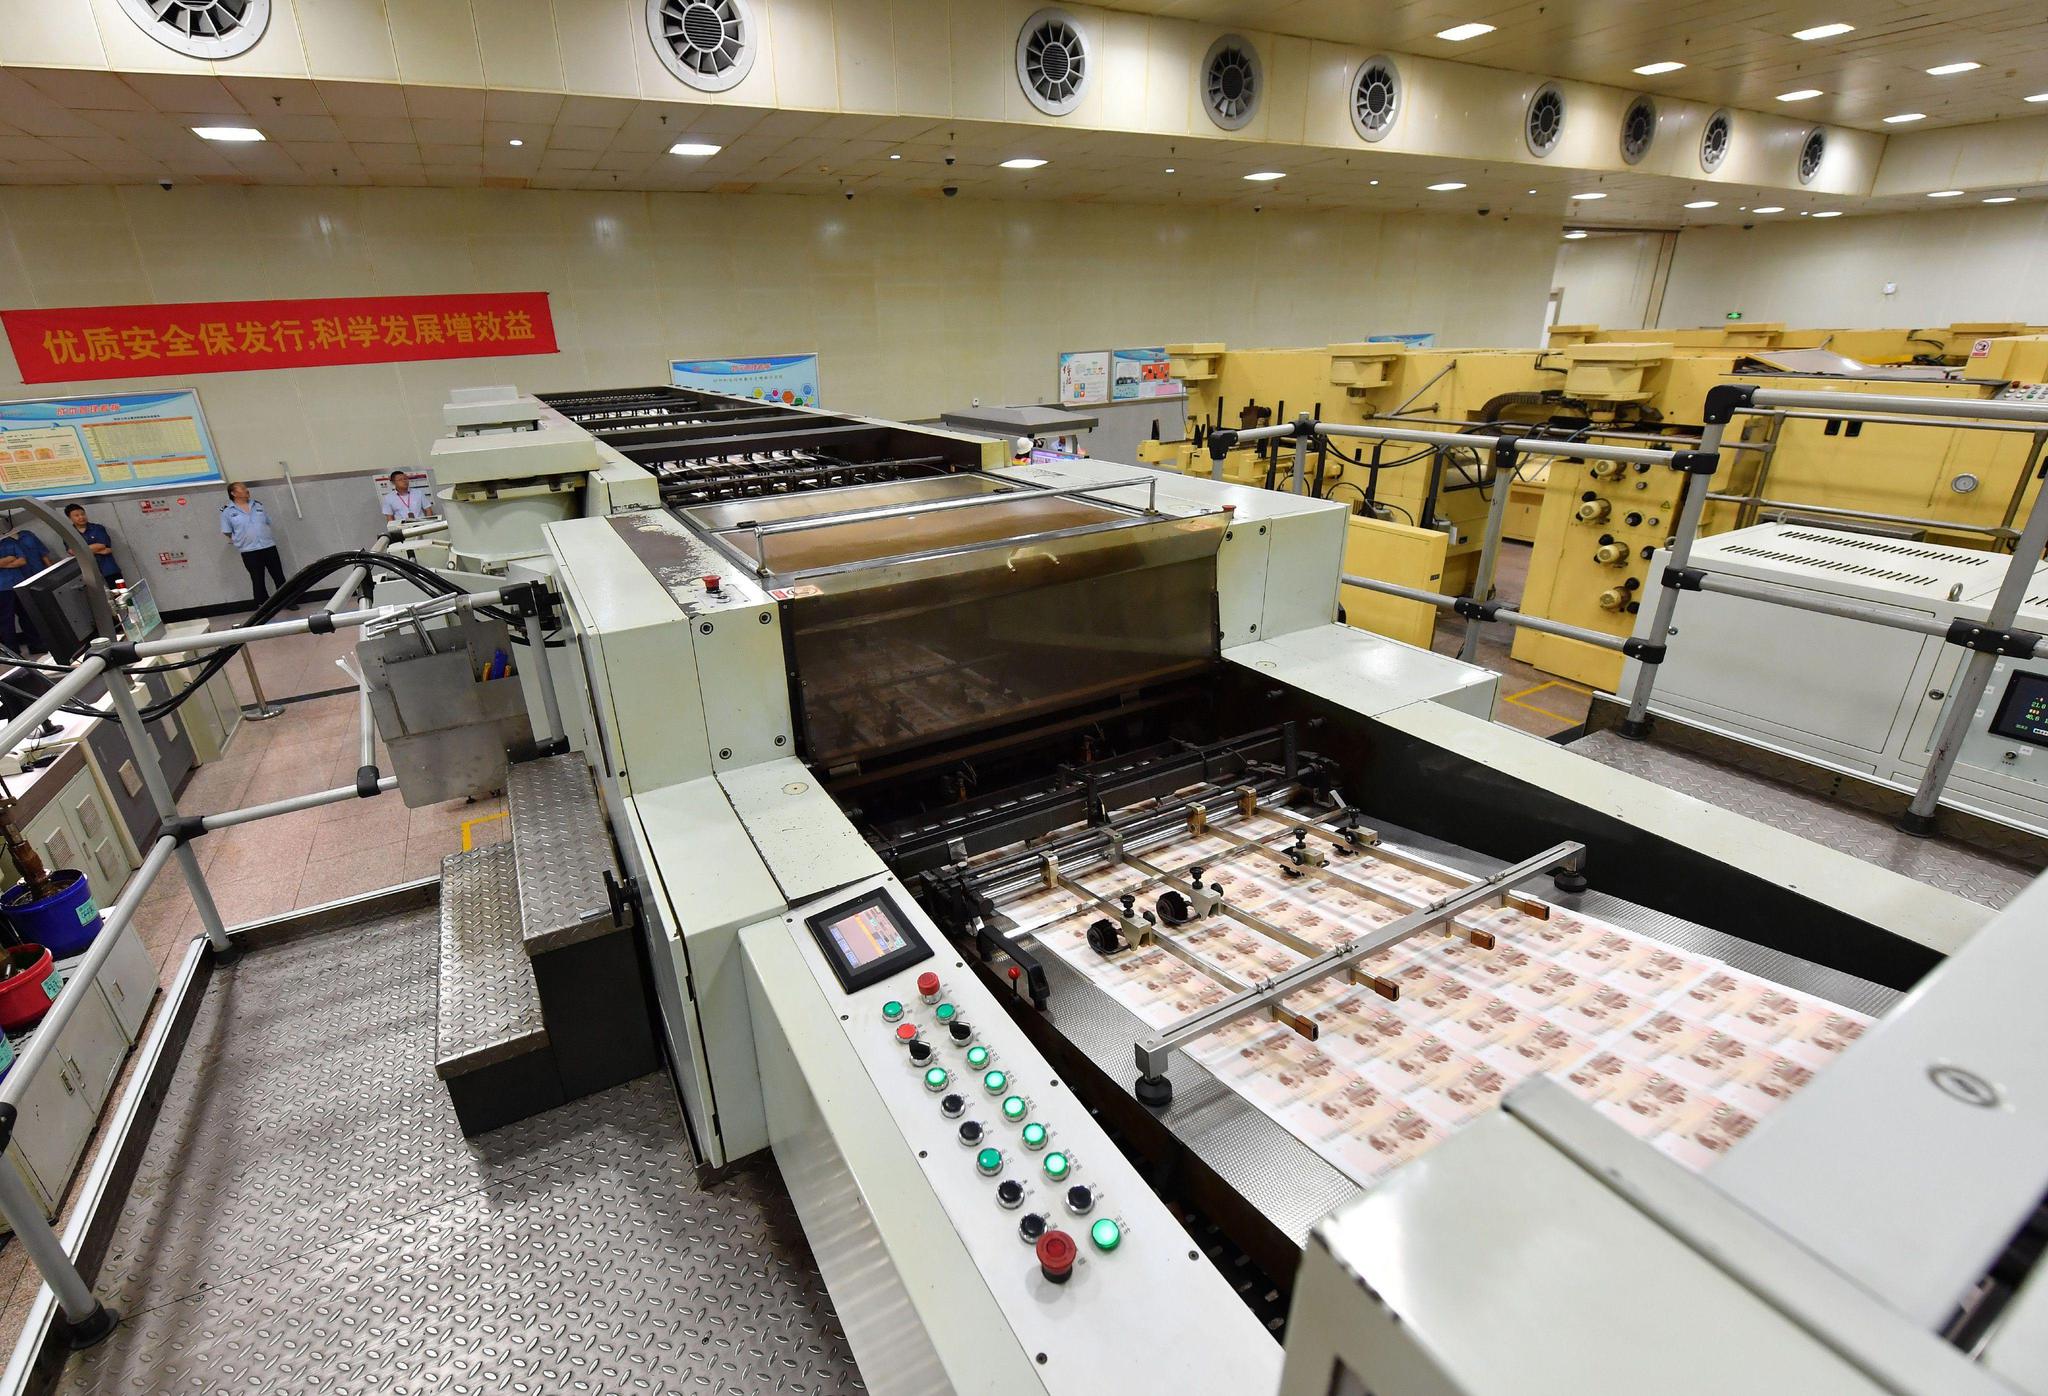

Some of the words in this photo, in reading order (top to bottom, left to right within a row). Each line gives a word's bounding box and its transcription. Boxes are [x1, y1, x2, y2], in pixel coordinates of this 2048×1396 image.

[42, 310, 536, 365] 优质安全保发行,科学发展增效益
